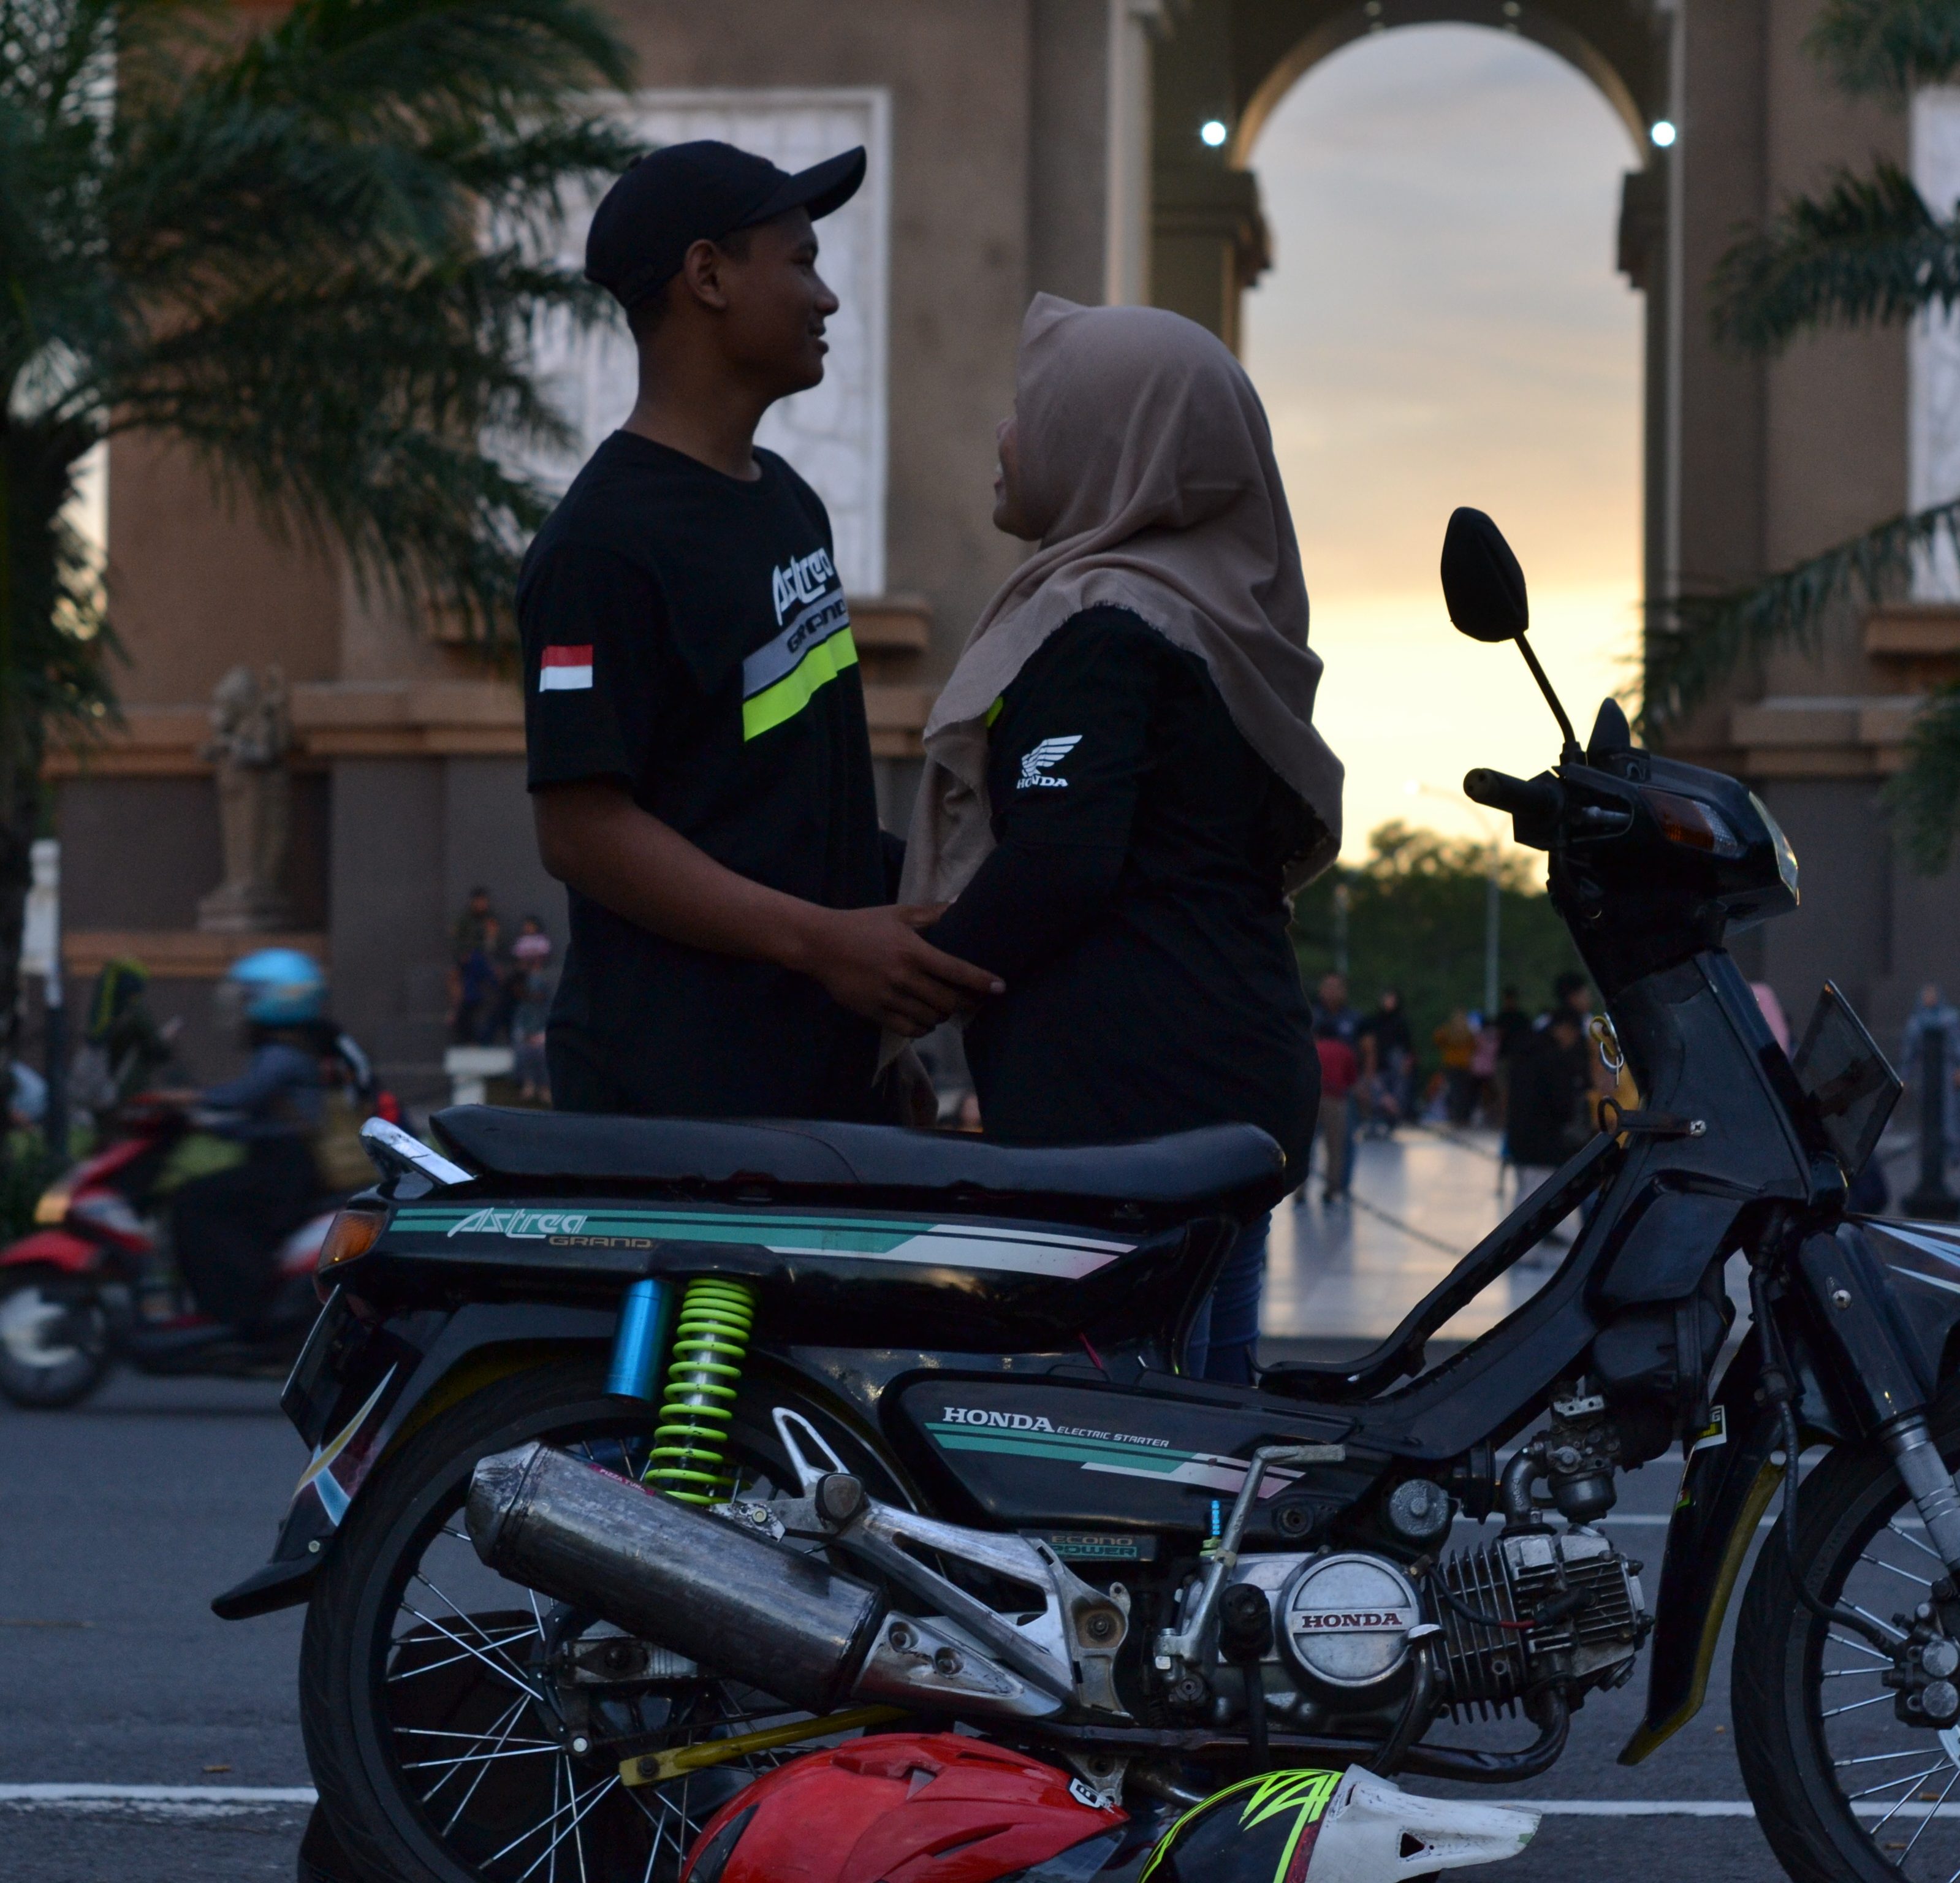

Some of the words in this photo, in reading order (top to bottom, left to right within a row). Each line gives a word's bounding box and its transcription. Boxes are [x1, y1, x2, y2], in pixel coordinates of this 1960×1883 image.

[1016, 775, 1069, 789] HONDA
[447, 1207, 588, 1239] Astrea
[549, 1236, 652, 1249] GRAND
[943, 1407, 1055, 1432] HONDA
[1057, 1426, 1111, 1440] ELECTRIC
[1113, 1433, 1169, 1448] STARTER
[1051, 1535, 1133, 1545] ECONO
[1052, 1545, 1134, 1556] POWER
[1302, 1613, 1402, 1628] HONDA
